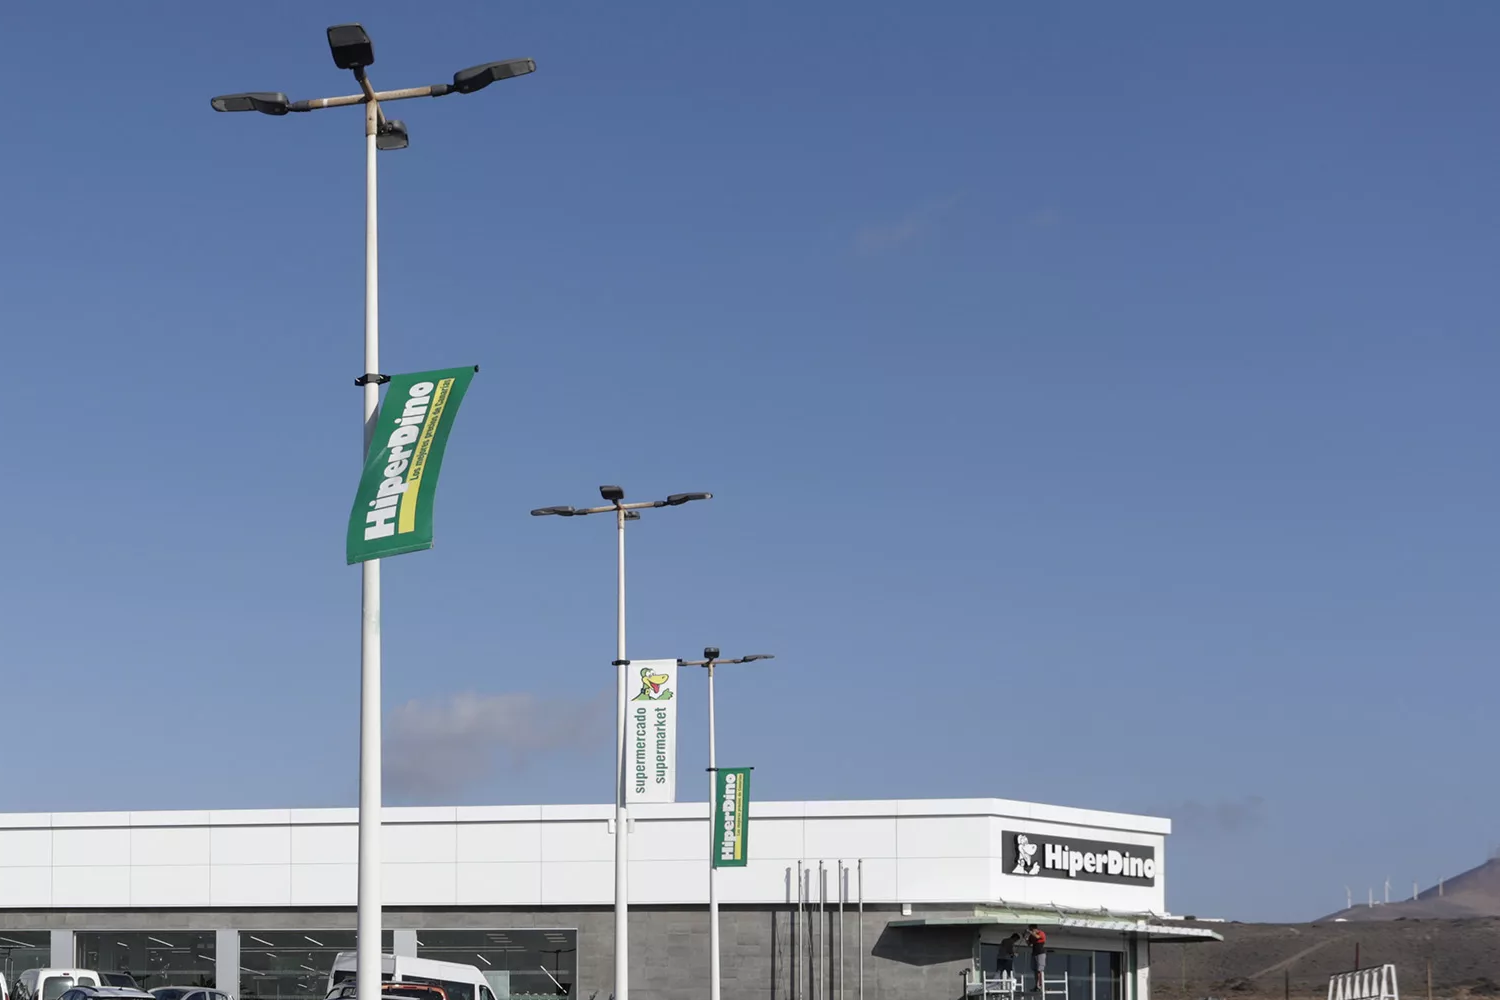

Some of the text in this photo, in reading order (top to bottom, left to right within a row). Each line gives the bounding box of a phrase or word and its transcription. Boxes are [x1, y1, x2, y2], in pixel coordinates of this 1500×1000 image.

[364, 382, 434, 540] HiperDino
[410, 467, 421, 481] Los
[634, 707, 648, 793] supermercado
[654, 707, 668, 784] supermarket
[721, 773, 737, 860] HiperDino
[1045, 843, 1155, 878] HiperDino
